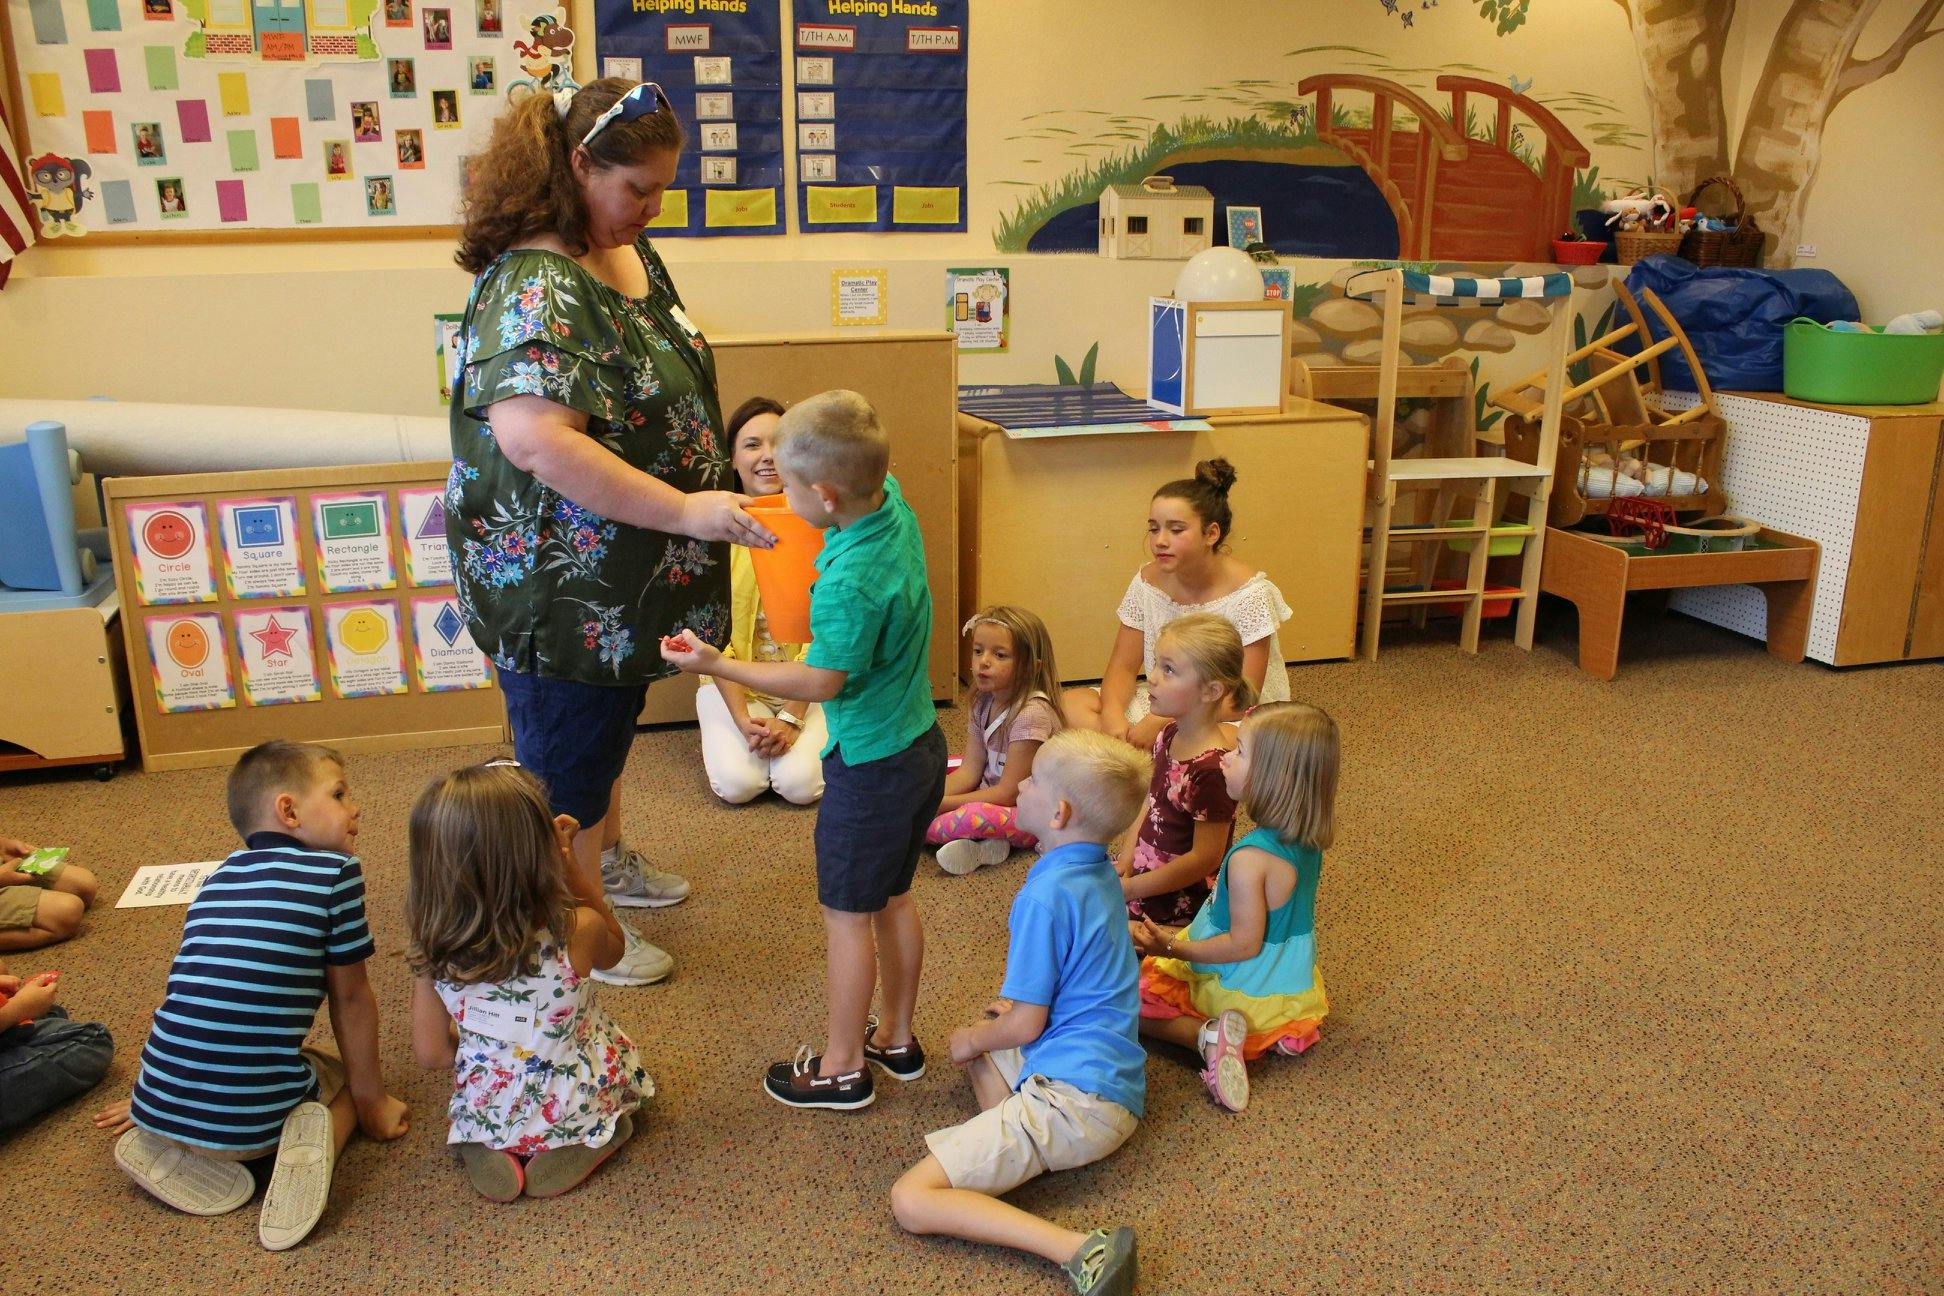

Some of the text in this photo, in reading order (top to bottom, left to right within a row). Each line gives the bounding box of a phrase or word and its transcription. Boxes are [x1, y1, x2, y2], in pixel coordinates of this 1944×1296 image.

[632, 0, 746, 14] Helping Hands
[828, 0, 938, 17] Helping Hands
[675, 32, 704, 45] MWF
[800, 30, 823, 44] T/TH
[911, 33, 933, 46] T/TH
[735, 206, 748, 214] Jobs
[1266, 289, 1280, 297] STOP
[327, 544, 379, 554] Rectangle
[243, 550, 283, 560] Square
[158, 563, 191, 572] Circle
[430, 647, 474, 657] Diamond
[267, 659, 288, 668] Star
[181, 668, 204, 677] Oval
